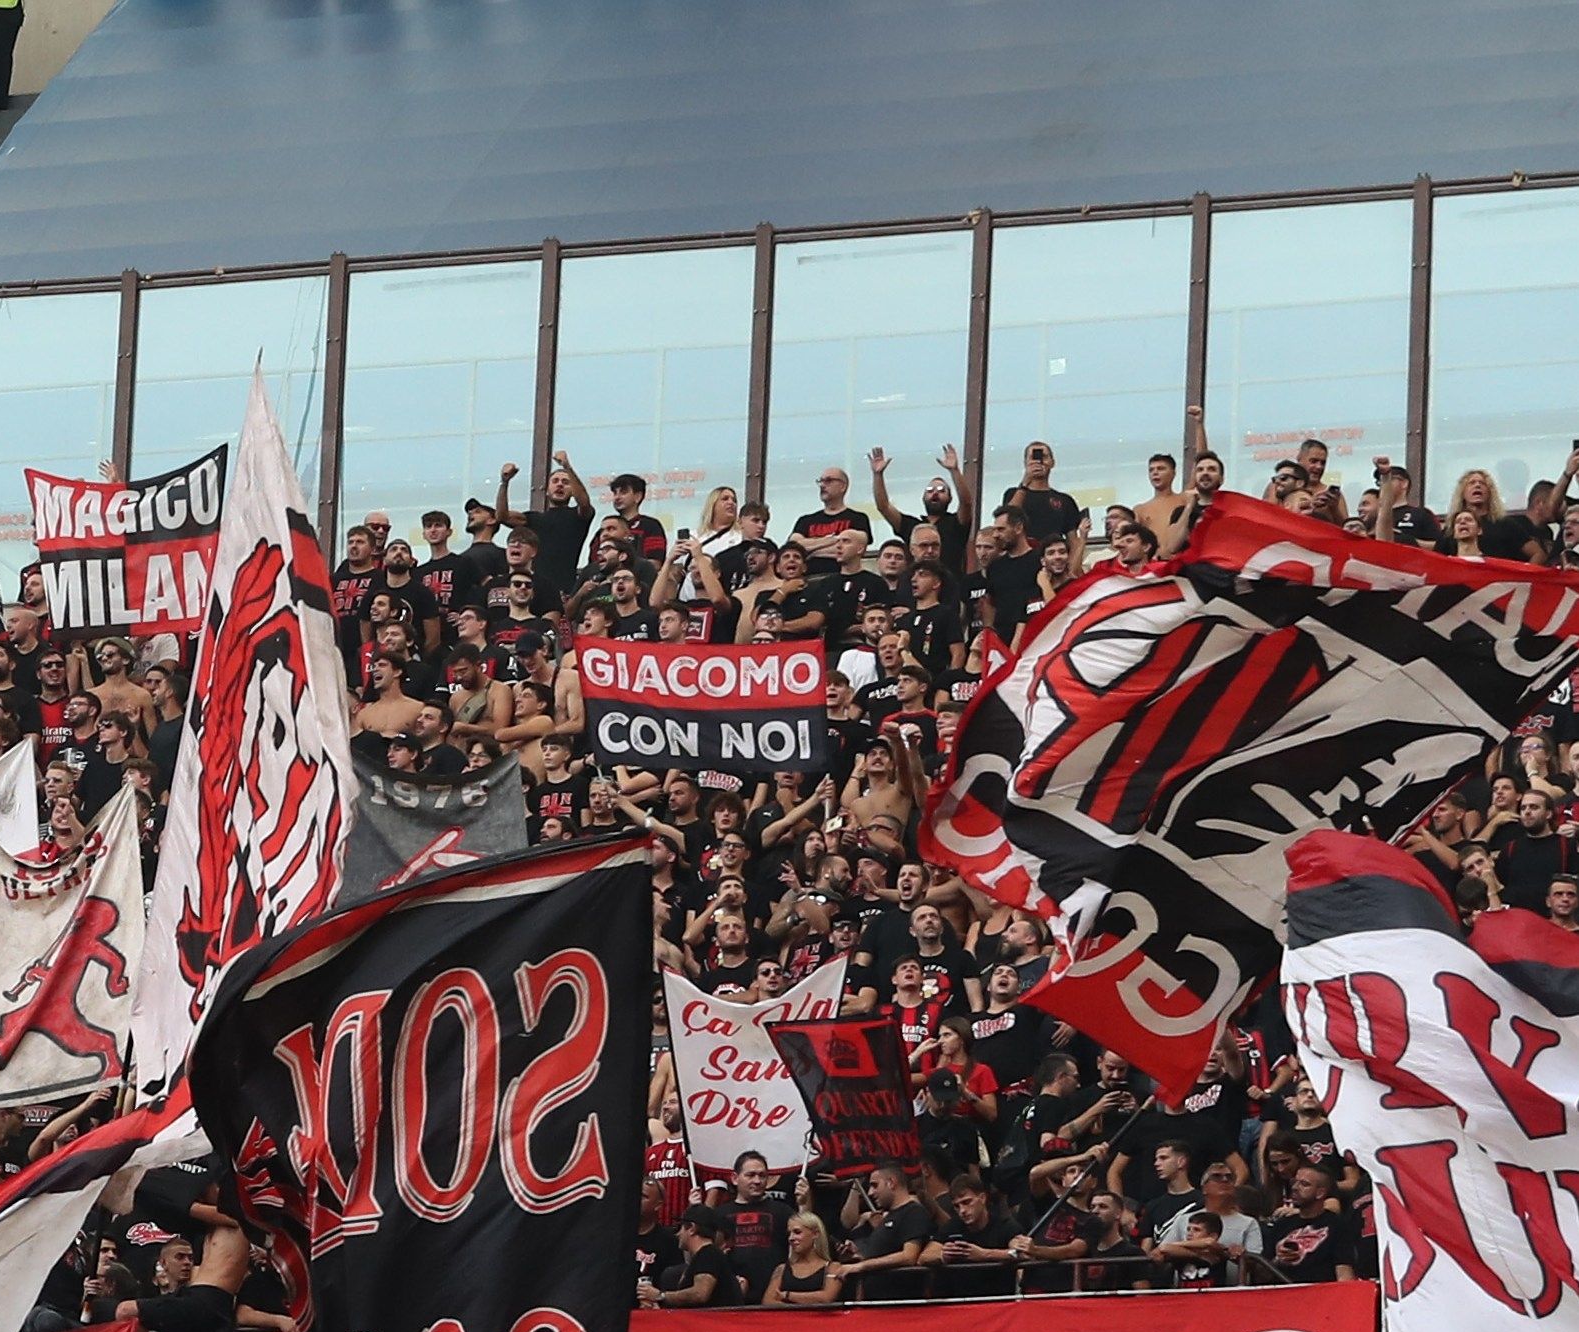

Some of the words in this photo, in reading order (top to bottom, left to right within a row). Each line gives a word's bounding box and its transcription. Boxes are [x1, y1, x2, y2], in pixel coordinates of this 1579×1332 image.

[33, 461, 222, 541] MAGICO
[44, 547, 217, 630] MILAN
[581, 648, 822, 698] GIACOMO
[597, 711, 701, 758] CON
[720, 718, 813, 761] NOI
[369, 774, 489, 810] 1976
[687, 1088, 796, 1131] Dire
